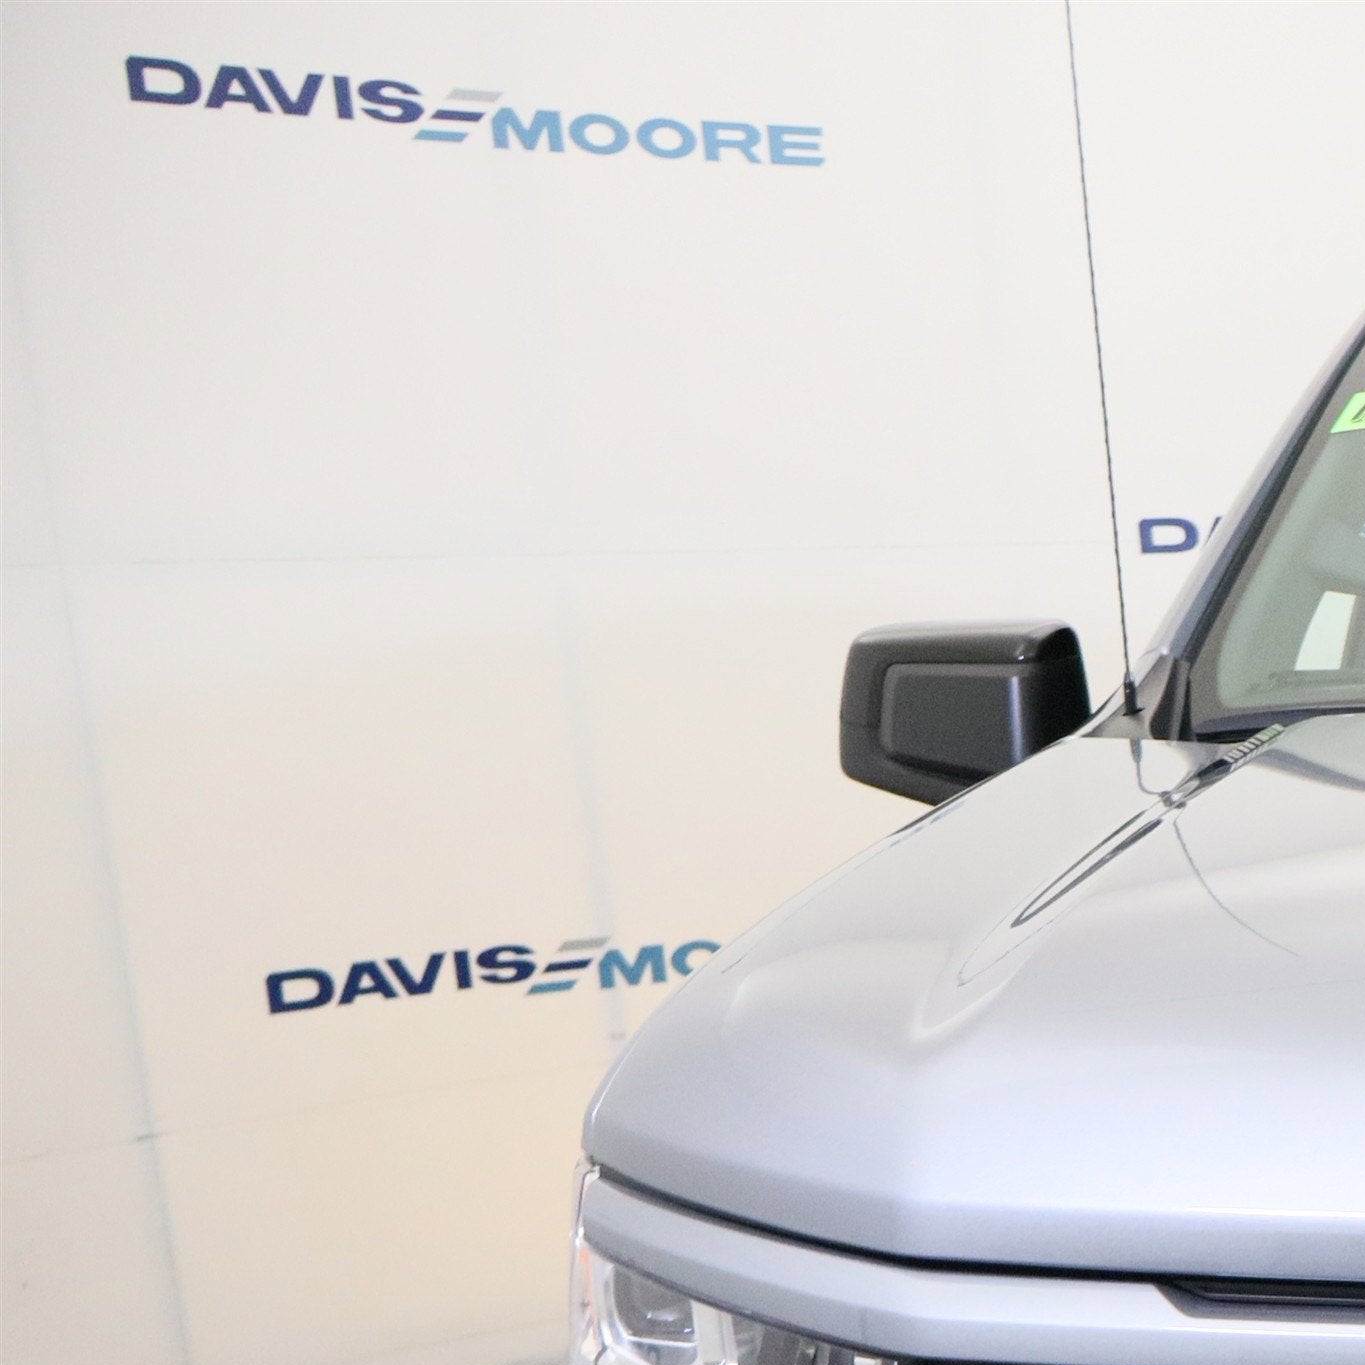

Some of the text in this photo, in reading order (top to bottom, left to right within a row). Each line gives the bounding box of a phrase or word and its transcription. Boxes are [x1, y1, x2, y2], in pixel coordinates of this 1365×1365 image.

[124, 55, 825, 167] DAVIS MOORE
[265, 944, 536, 1015] DAVIS
